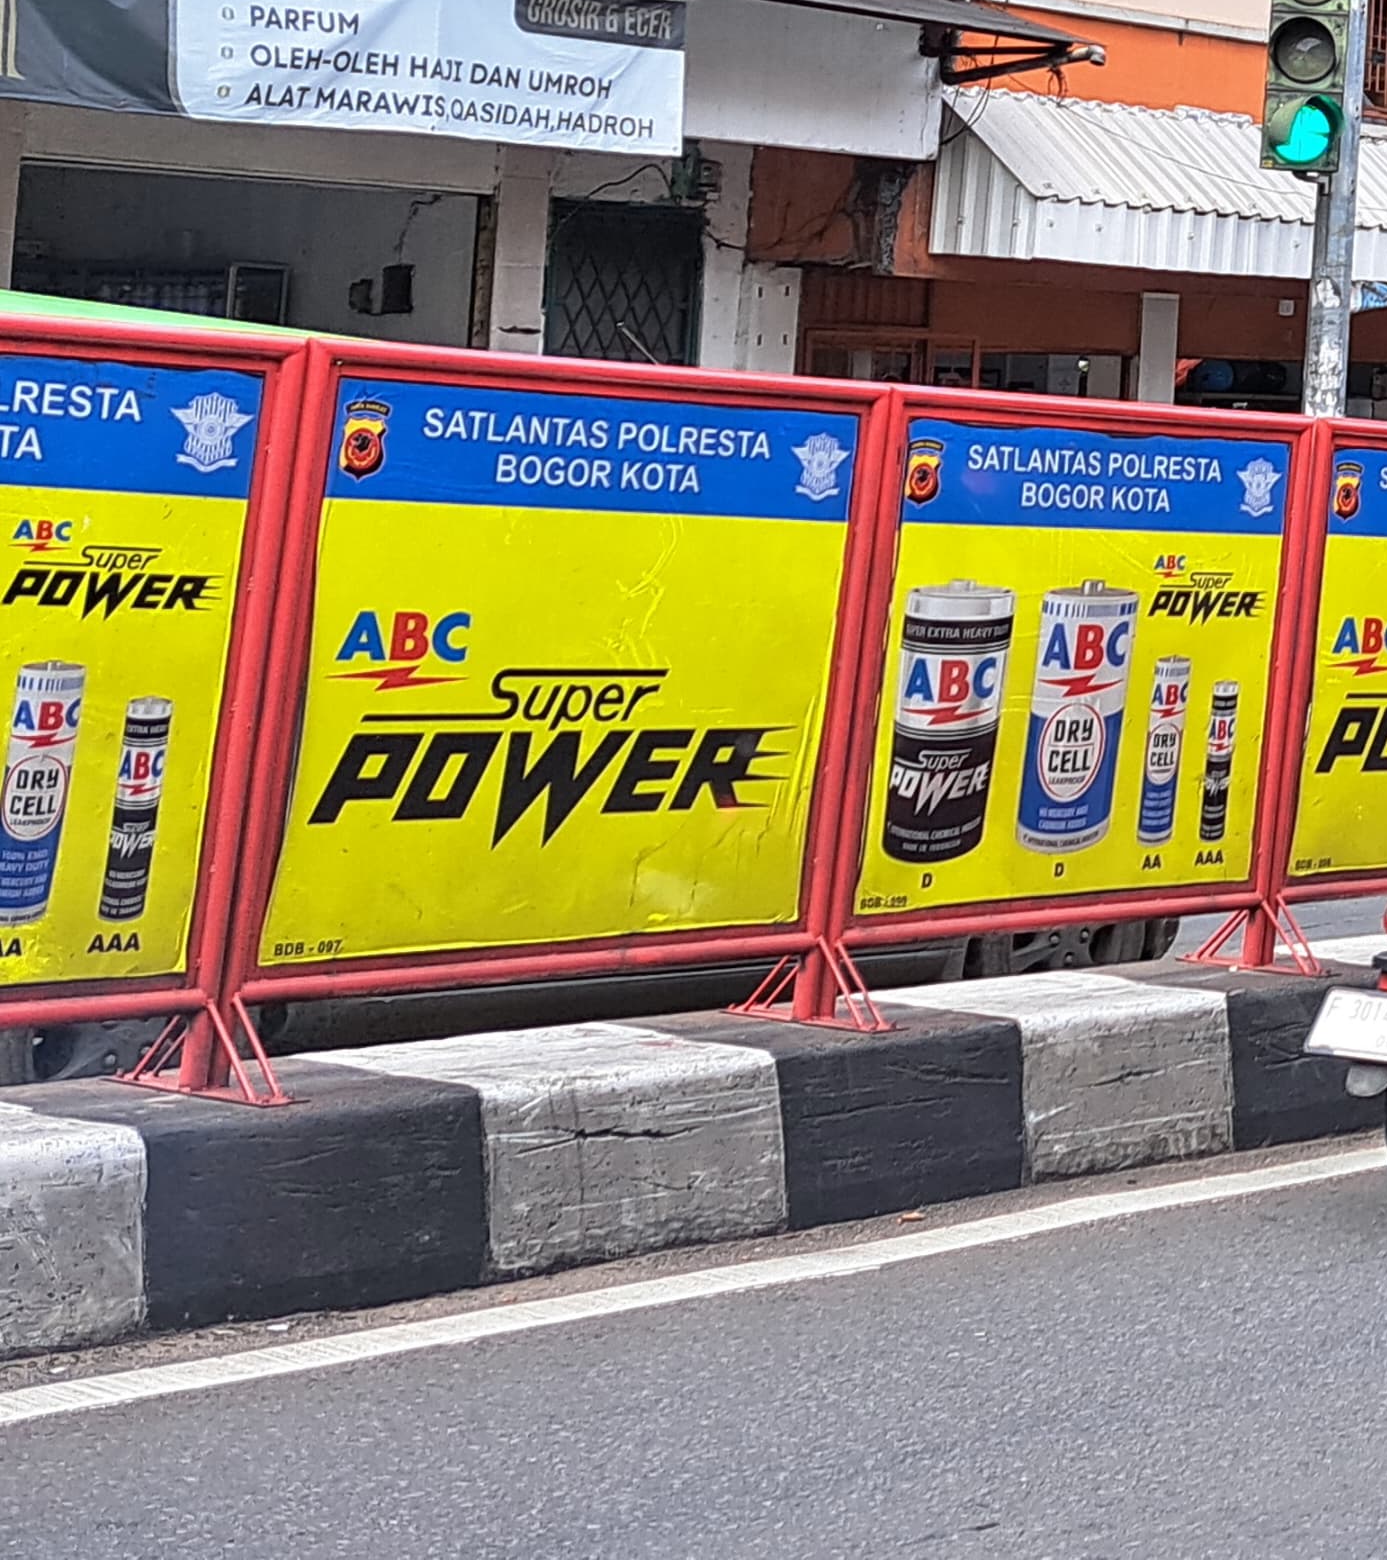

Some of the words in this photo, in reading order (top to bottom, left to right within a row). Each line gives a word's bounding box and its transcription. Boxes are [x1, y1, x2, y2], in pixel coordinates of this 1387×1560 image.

[250, 5, 360, 35] PARFUM
[605, 5, 618, 32] &
[624, 6, 672, 40] ECER
[250, 44, 399, 76] OLEH-OLEH
[410, 55, 462, 82] HAJI
[469, 62, 520, 90] DAN
[528, 68, 612, 99] UMROH
[245, 83, 310, 109] ALAT
[422, 407, 609, 450] SATLANTAS
[617, 420, 771, 460] POLRESTA
[495, 455, 610, 490] BOGOR
[619, 461, 700, 494] KOTA
[968, 444, 1102, 476] SATLANTAS
[1108, 452, 1222, 482] POLRESTA
[1020, 480, 1104, 510] BOGOR
[1111, 486, 1171, 513] KOTA
[13, 520, 73, 542] ABC
[68, 545, 163, 572] Super
[1154, 554, 1187, 571] ABC
[1180, 571, 1234, 591] Super
[2, 569, 220, 621] POWER
[1148, 590, 1264, 626] POWER
[336, 609, 472, 663] ABC
[927, 624, 960, 639] EXTRA
[1042, 621, 1130, 671] ABC
[904, 657, 998, 703] ABC
[450, 668, 671, 732] Super
[1152, 682, 1188, 706] ABC
[13, 697, 81, 731] ABC
[1054, 717, 1094, 743] DRY
[1153, 732, 1177, 749] DRY
[119, 748, 164, 781] ABC
[908, 748, 973, 772] Super
[1048, 748, 1092, 774] CELL
[1150, 751, 1175, 767] CELL
[16, 768, 60, 791] DRY
[307, 726, 788, 850] POWER
[889, 759, 991, 817] POWER
[10, 795, 57, 817] CELL
[1054, 862, 1065, 878] D
[1141, 853, 1161, 870] AA
[1194, 849, 1224, 866] AAA
[921, 872, 933, 889] D
[87, 932, 141, 955] AAA
[1326, 996, 1343, 1019] F
